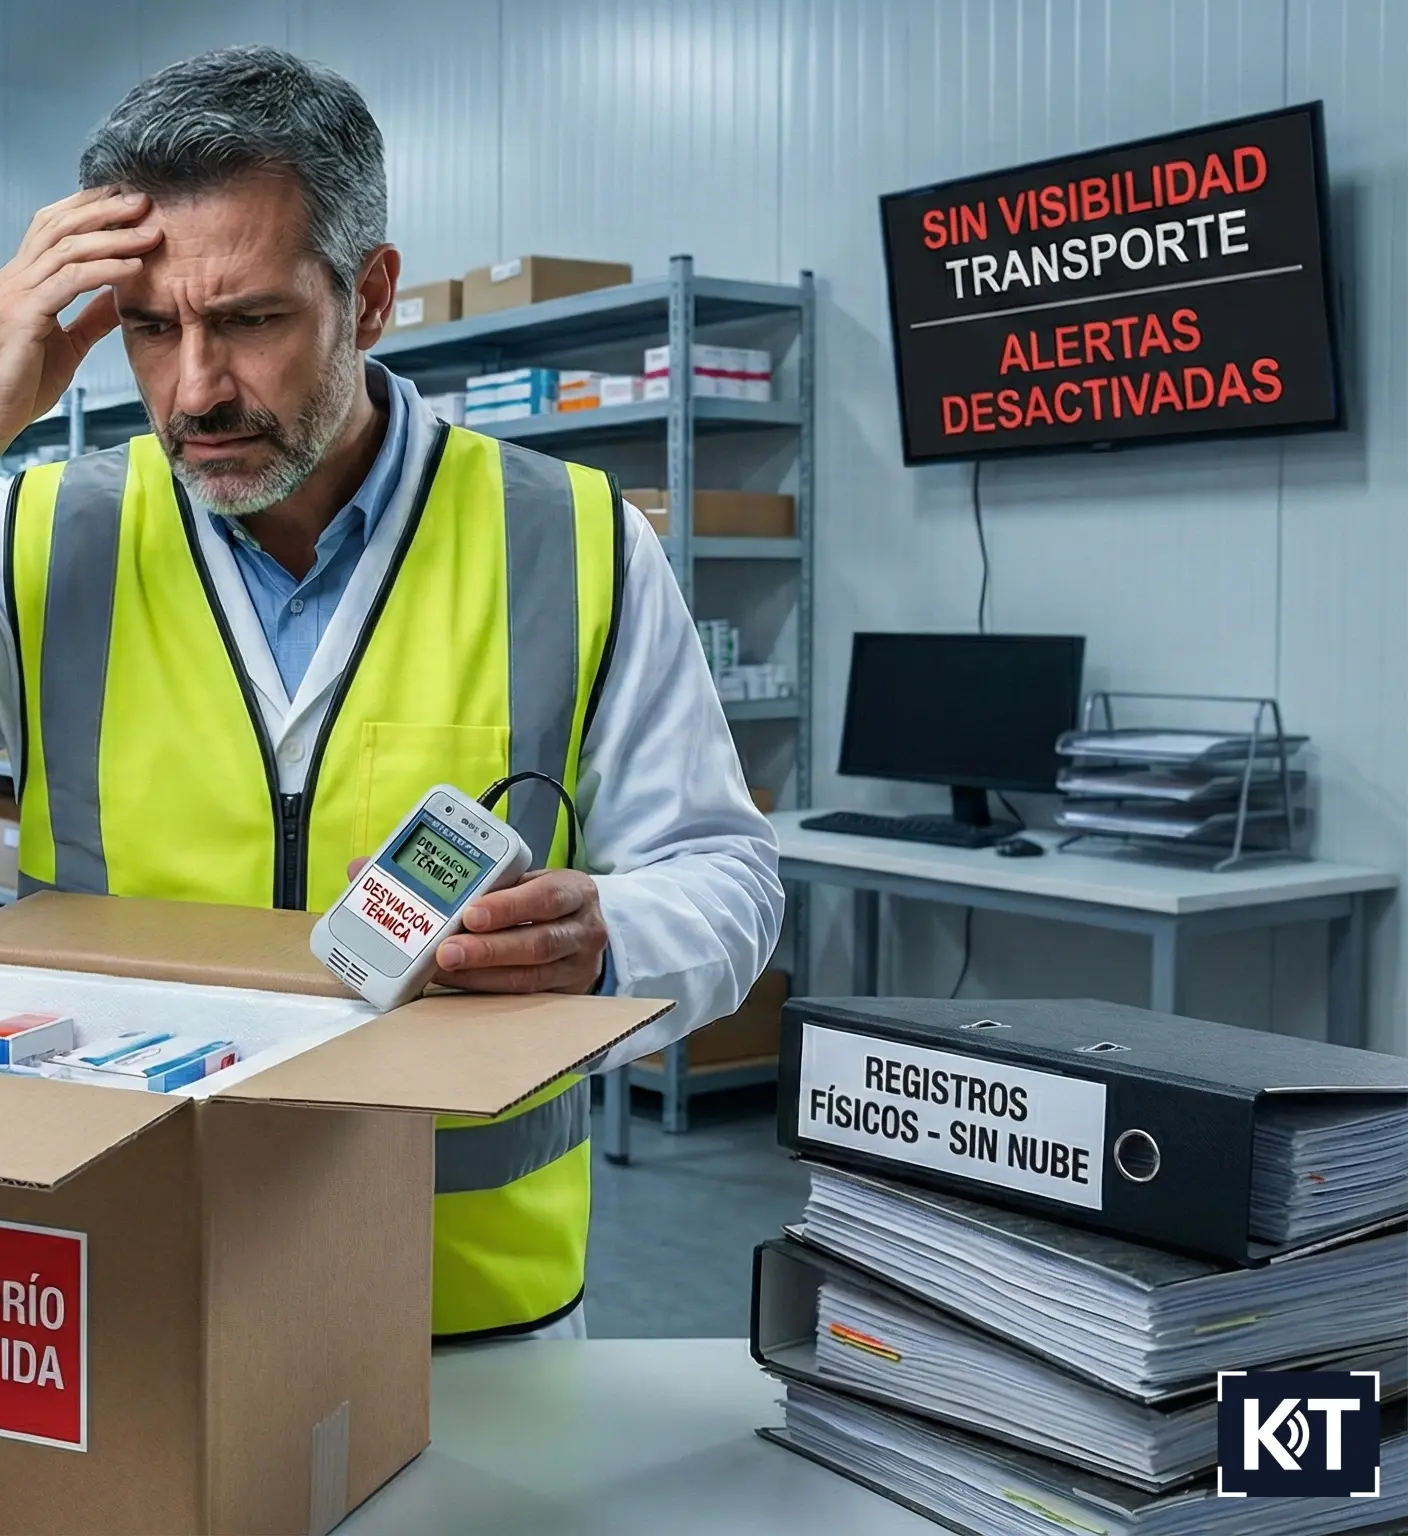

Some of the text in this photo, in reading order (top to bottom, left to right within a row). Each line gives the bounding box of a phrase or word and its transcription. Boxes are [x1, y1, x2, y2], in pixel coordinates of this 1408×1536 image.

[923, 146, 1268, 249] SIN VISIBILIDAD
[945, 208, 1250, 299] TRANSPORTE
[1000, 307, 1203, 374] ALERTAS
[942, 357, 1284, 434] DESACTIVADAS
[362, 876, 434, 937] DESVIACIÓN
[865, 1054, 1029, 1122] REGISTROS
[810, 1083, 1091, 1186] FÍSICOS - SIN NUBE
